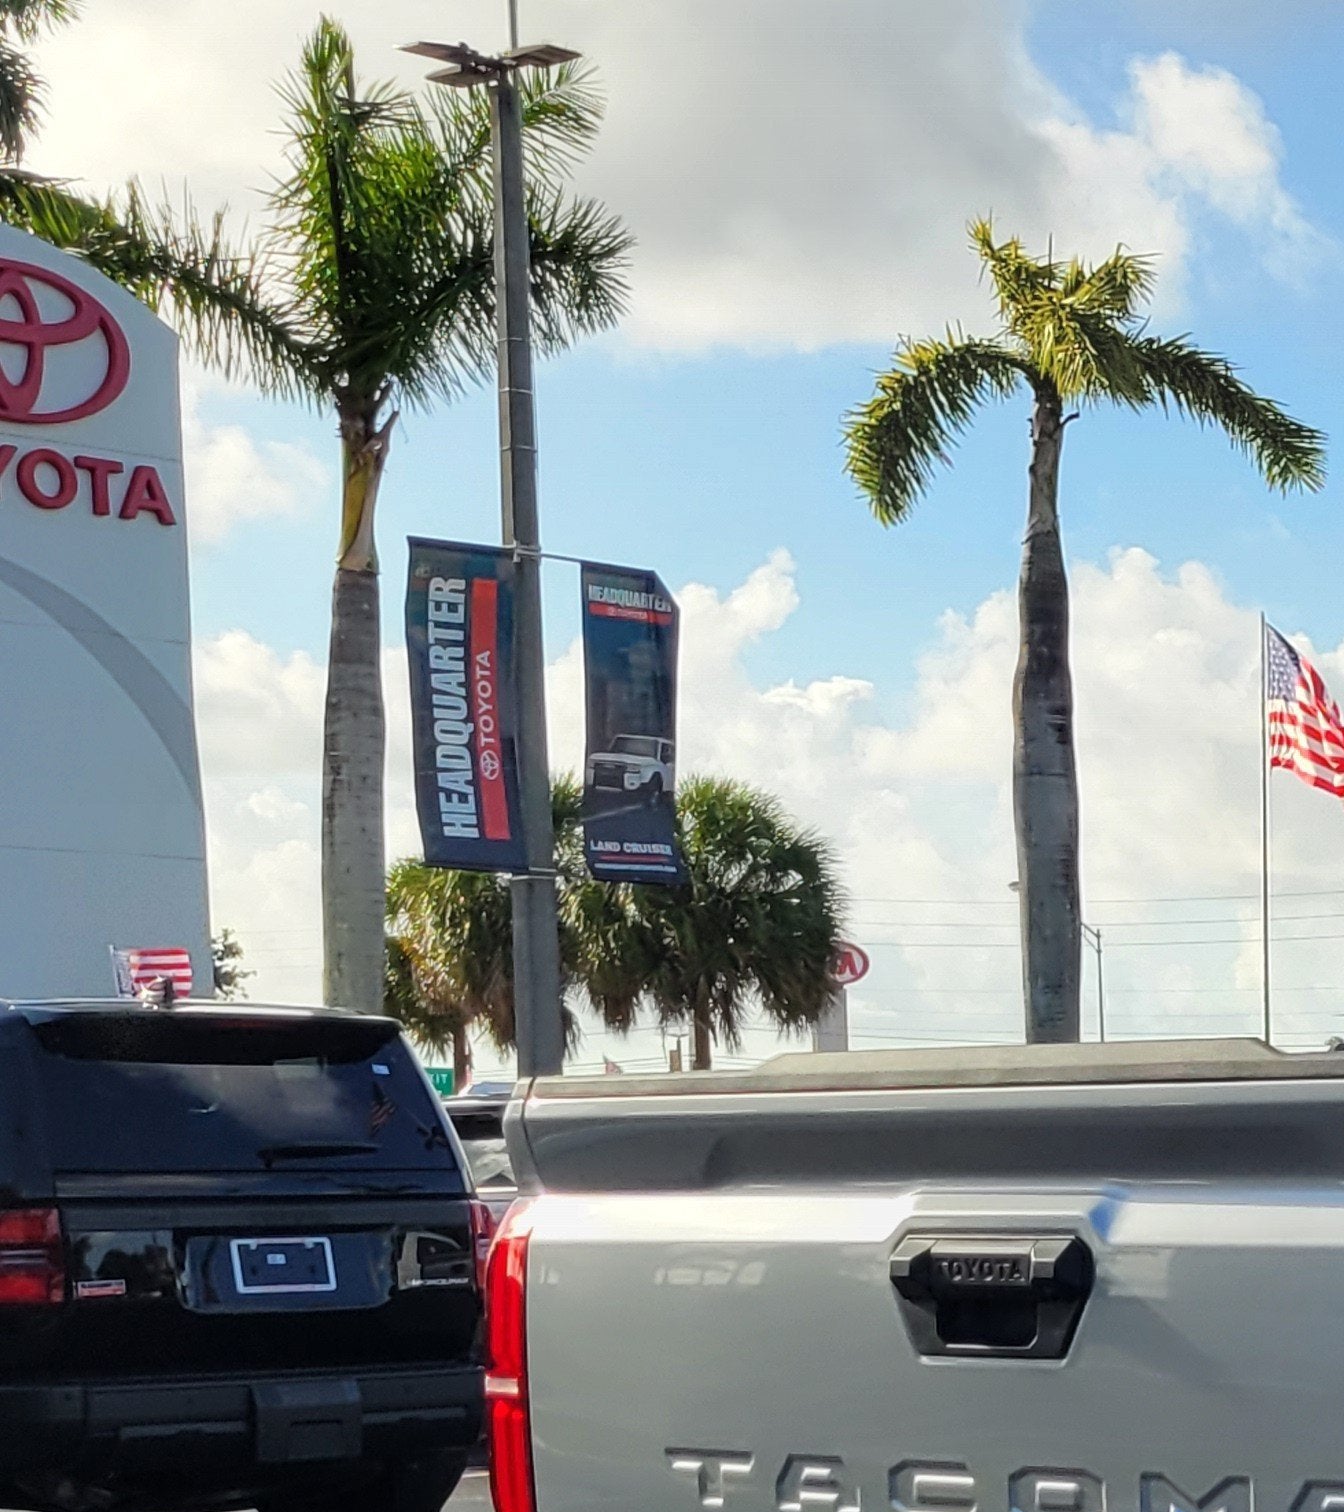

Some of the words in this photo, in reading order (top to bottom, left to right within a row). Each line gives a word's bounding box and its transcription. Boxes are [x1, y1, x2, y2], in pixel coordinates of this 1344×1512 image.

[428, 577, 480, 839] HEADQUARTER
[476, 650, 499, 747] TOYOTA
[590, 839, 621, 852] LAND
[623, 842, 673, 856] CRUISER
[938, 1257, 1026, 1282] TOYOTA
